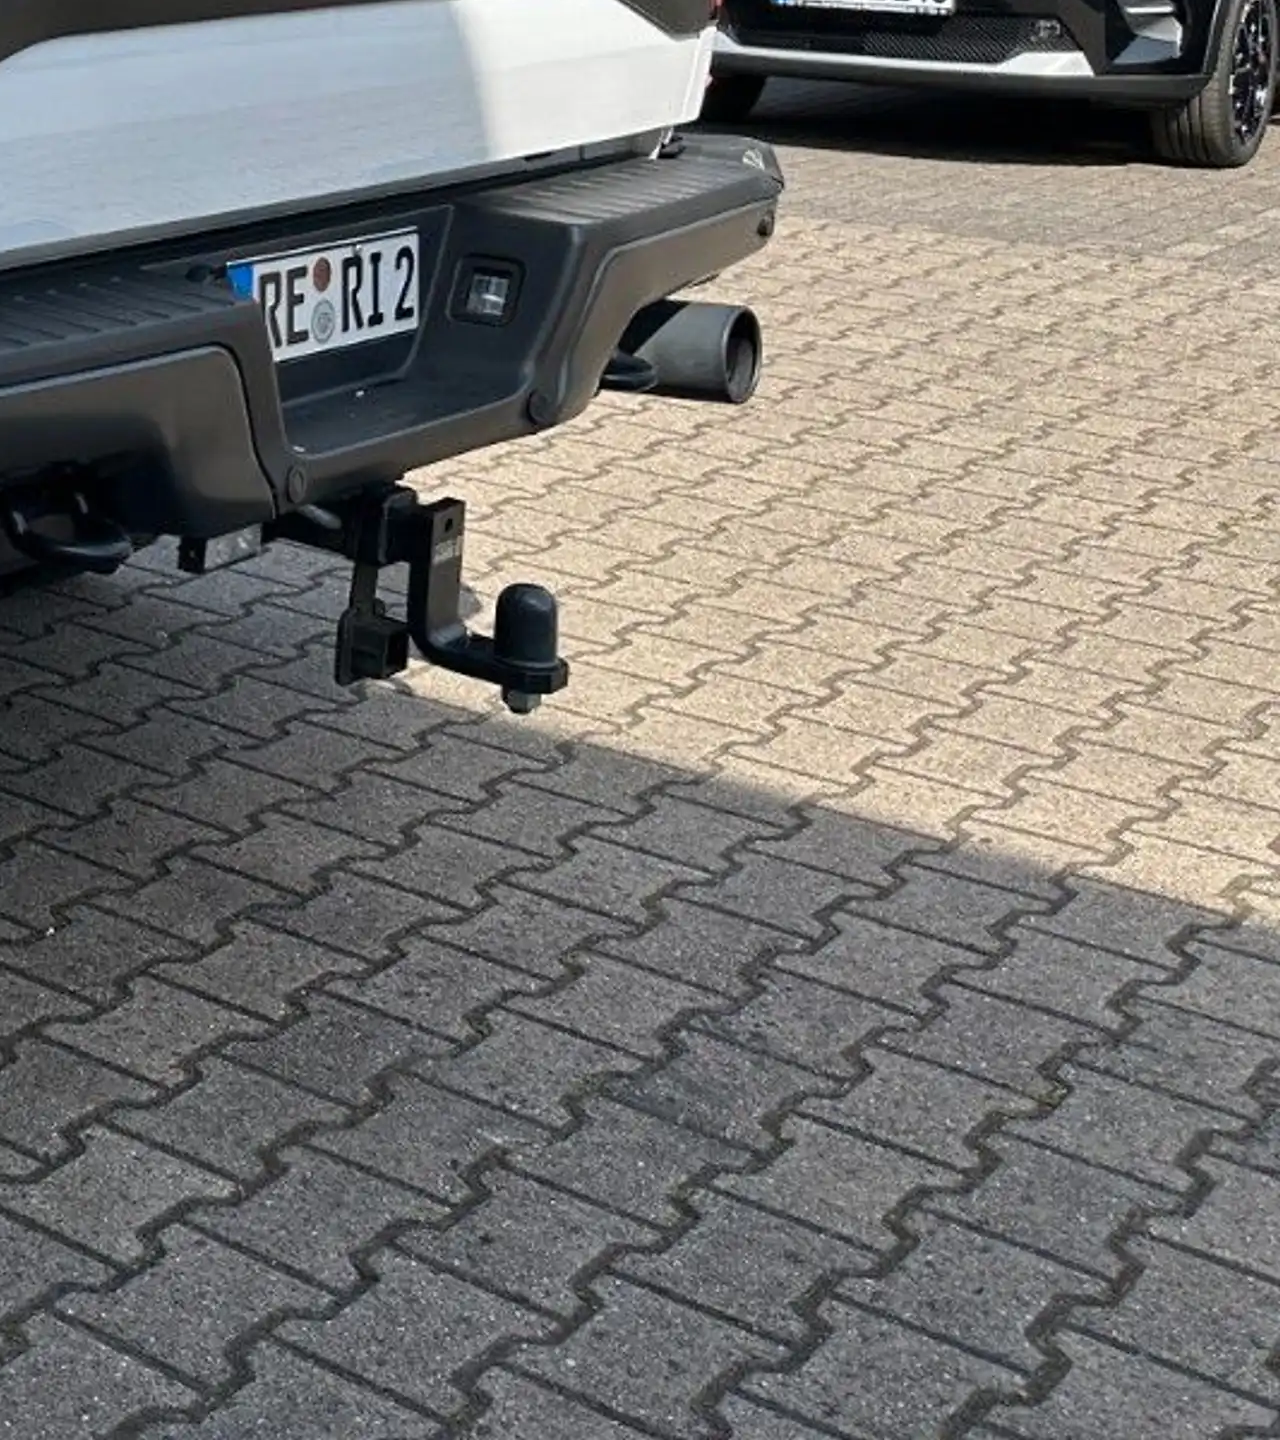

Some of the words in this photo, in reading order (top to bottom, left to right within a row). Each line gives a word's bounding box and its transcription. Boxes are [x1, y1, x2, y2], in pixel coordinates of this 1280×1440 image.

[259, 264, 309, 348] RE
[342, 251, 384, 333] RI
[394, 245, 414, 320] 2
